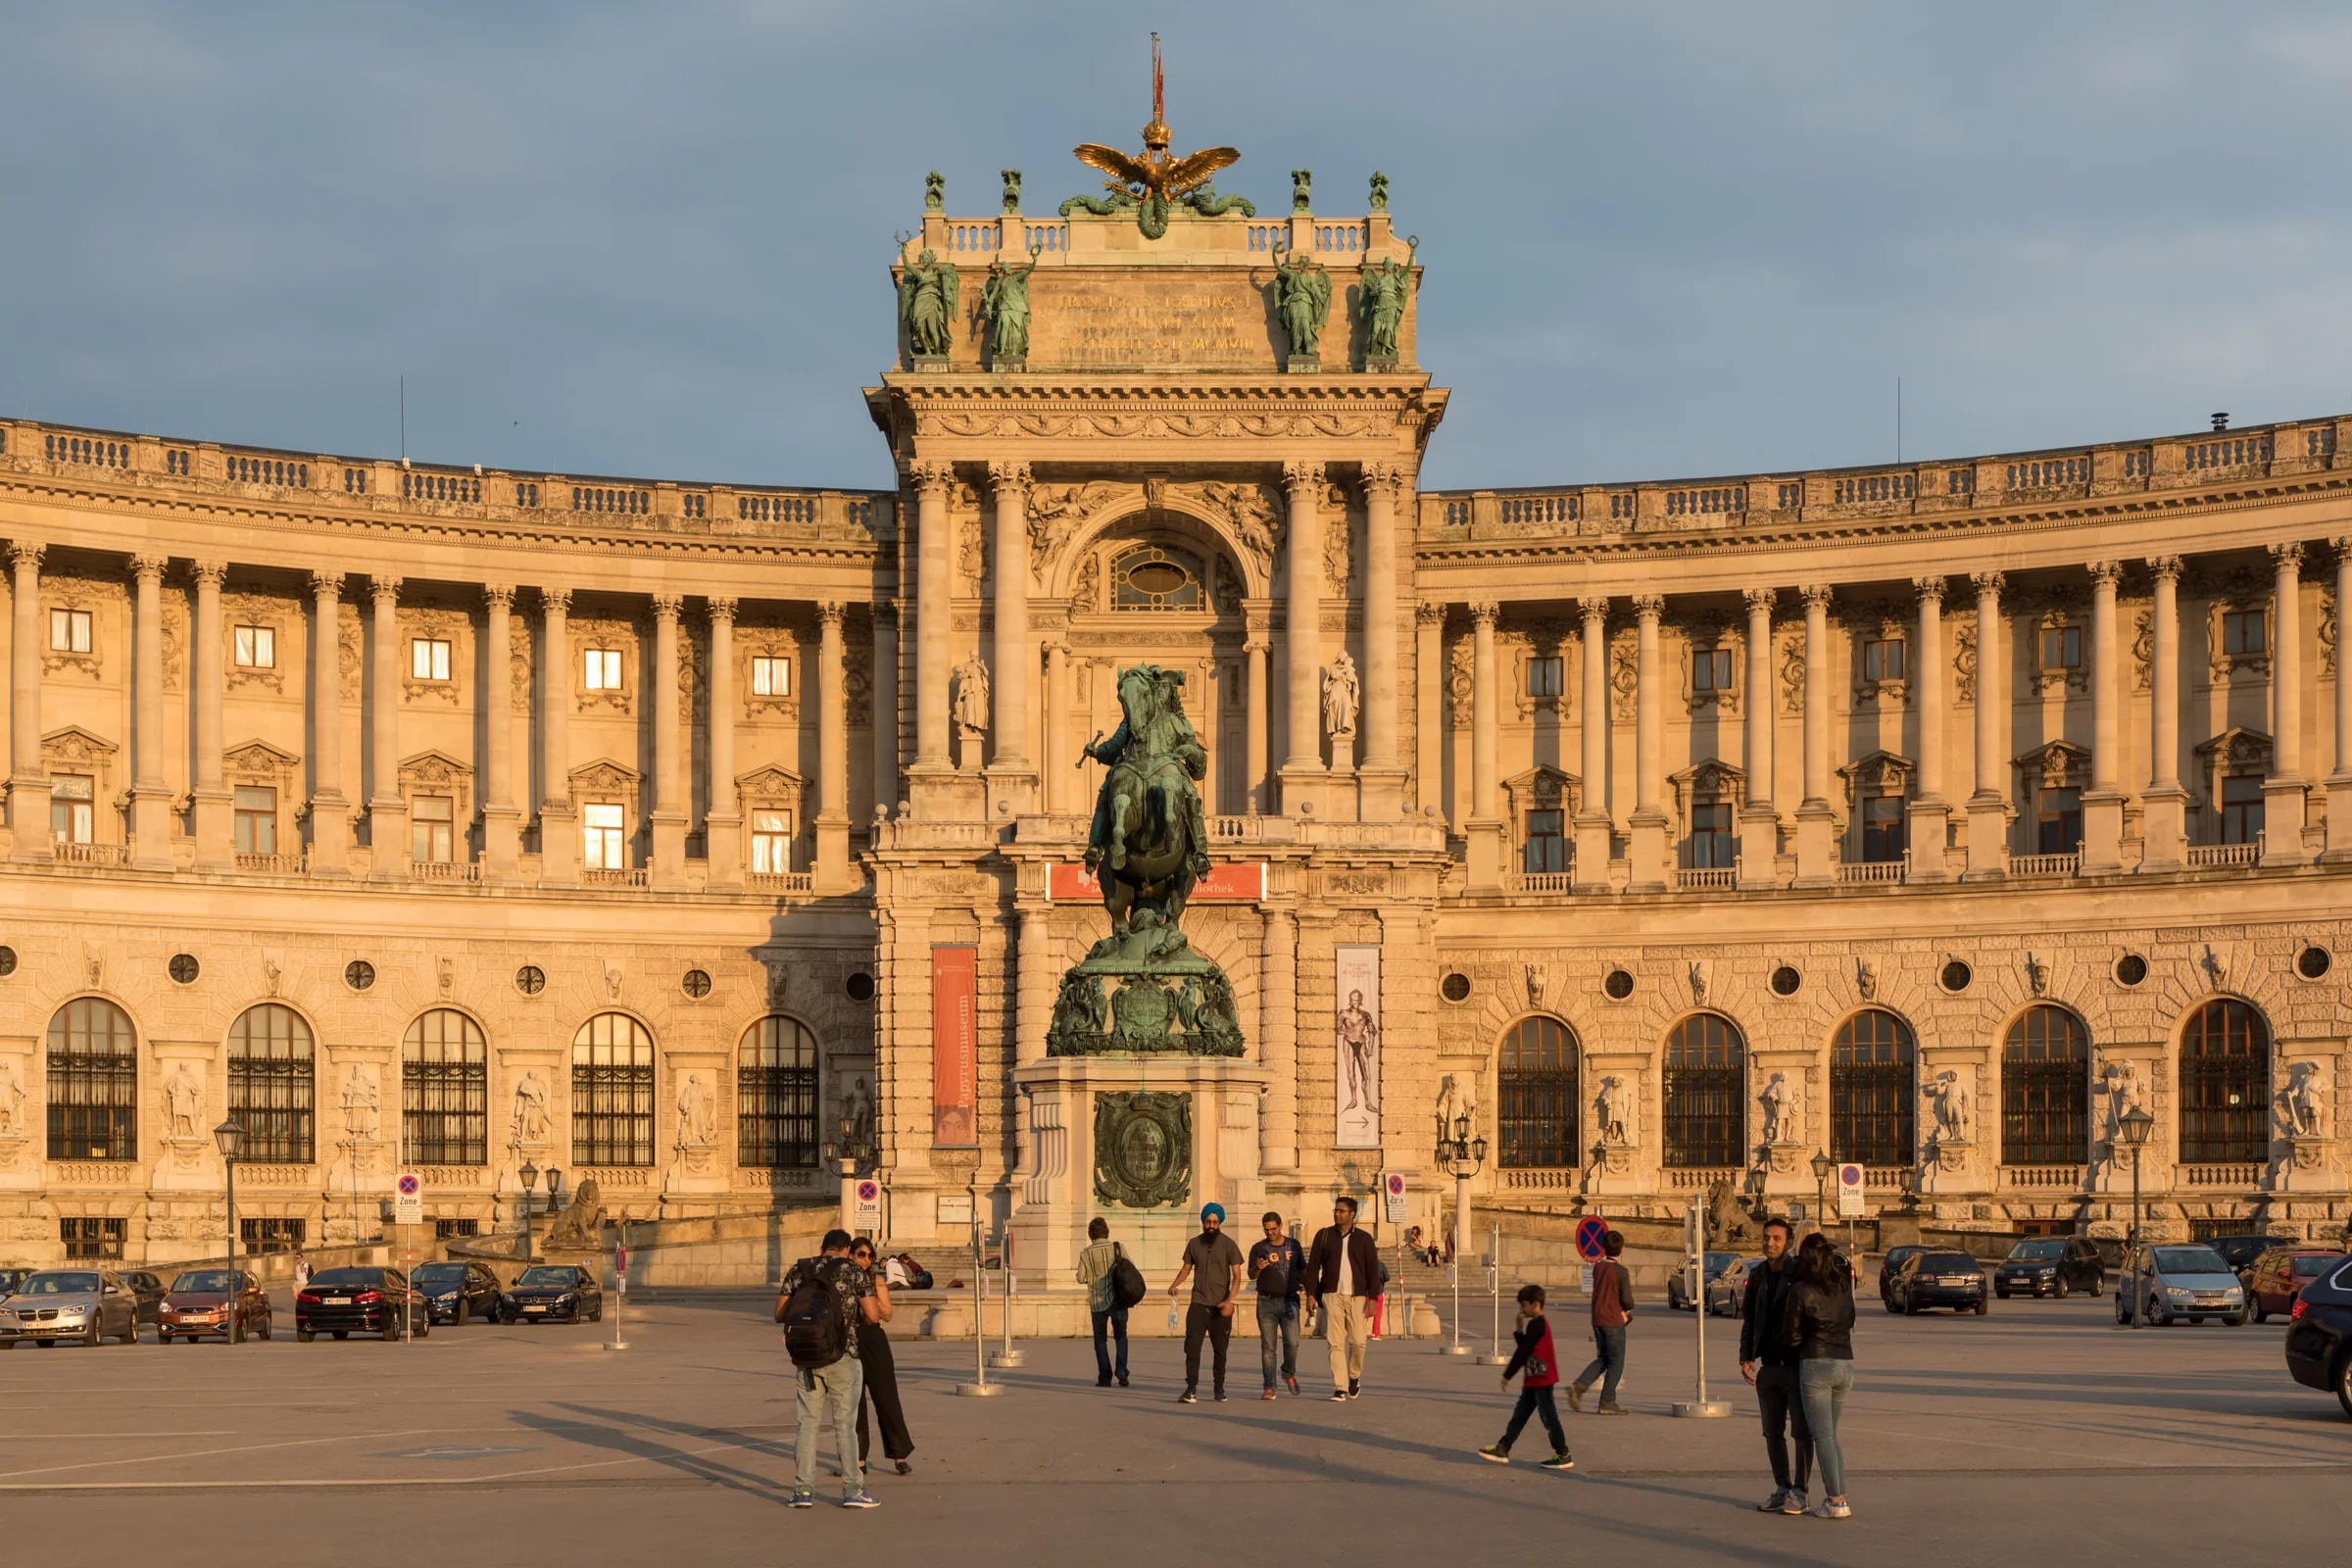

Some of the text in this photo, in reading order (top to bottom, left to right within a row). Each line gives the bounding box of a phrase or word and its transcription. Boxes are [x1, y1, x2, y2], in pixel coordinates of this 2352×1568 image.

[958, 995, 971, 1108] Papyrusmuseum
[1843, 1187, 1859, 1196] Zone
[400, 1197, 417, 1205] Zone
[858, 1202, 876, 1211] Zone
